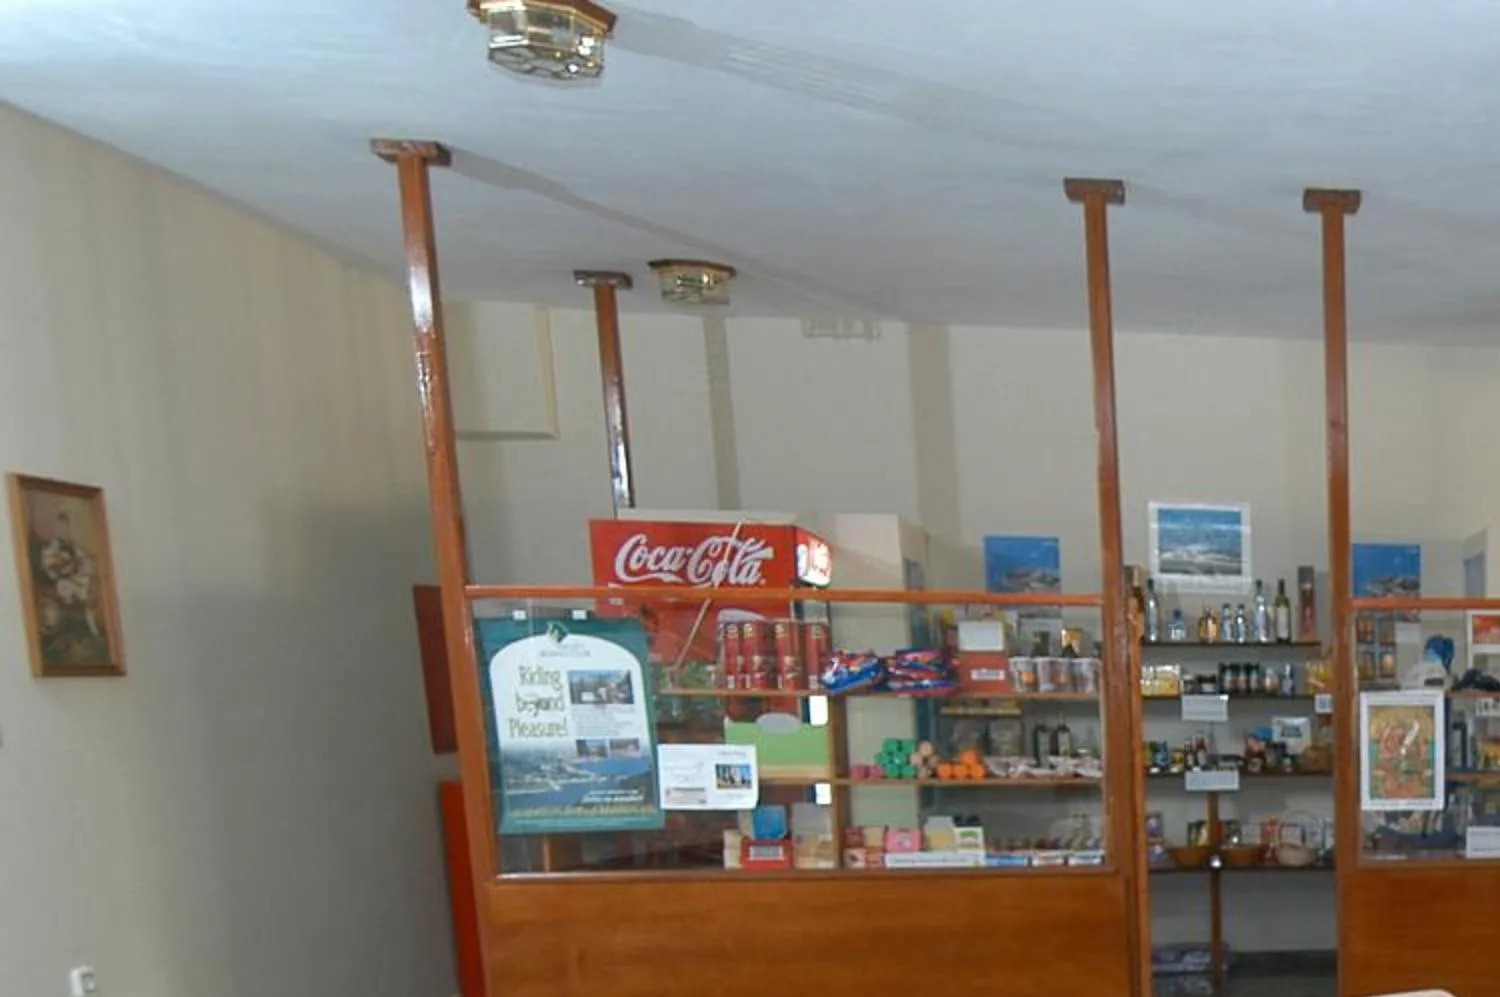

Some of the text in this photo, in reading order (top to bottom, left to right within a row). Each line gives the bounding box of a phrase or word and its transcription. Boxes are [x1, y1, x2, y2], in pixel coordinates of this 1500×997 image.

[614, 533, 774, 587] Coca-Cola
[519, 666, 562, 690] Riding
[516, 691, 565, 717] beyond
